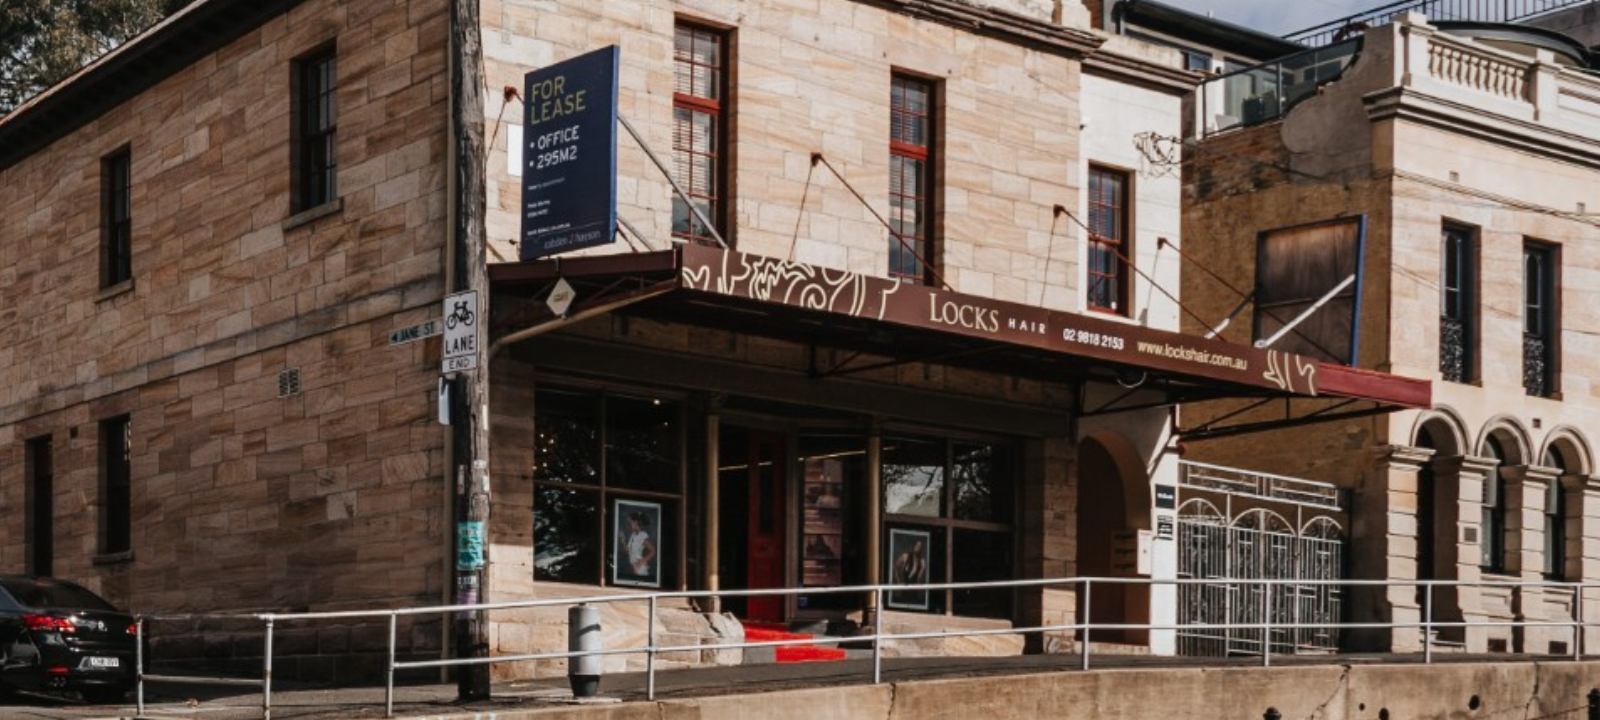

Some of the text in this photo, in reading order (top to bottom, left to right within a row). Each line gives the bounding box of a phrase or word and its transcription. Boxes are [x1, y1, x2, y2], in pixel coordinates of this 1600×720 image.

[532, 75, 566, 103] FOR
[531, 90, 587, 125] LEASE
[537, 125, 580, 150] OFFICE
[536, 145, 578, 169] 295M2
[423, 321, 435, 336] ST
[929, 292, 1248, 371] LOCKS HAIR 02 9818 2153 www.lockshair.com.au
[445, 335, 475, 355] LANE
[448, 357, 470, 370] END
